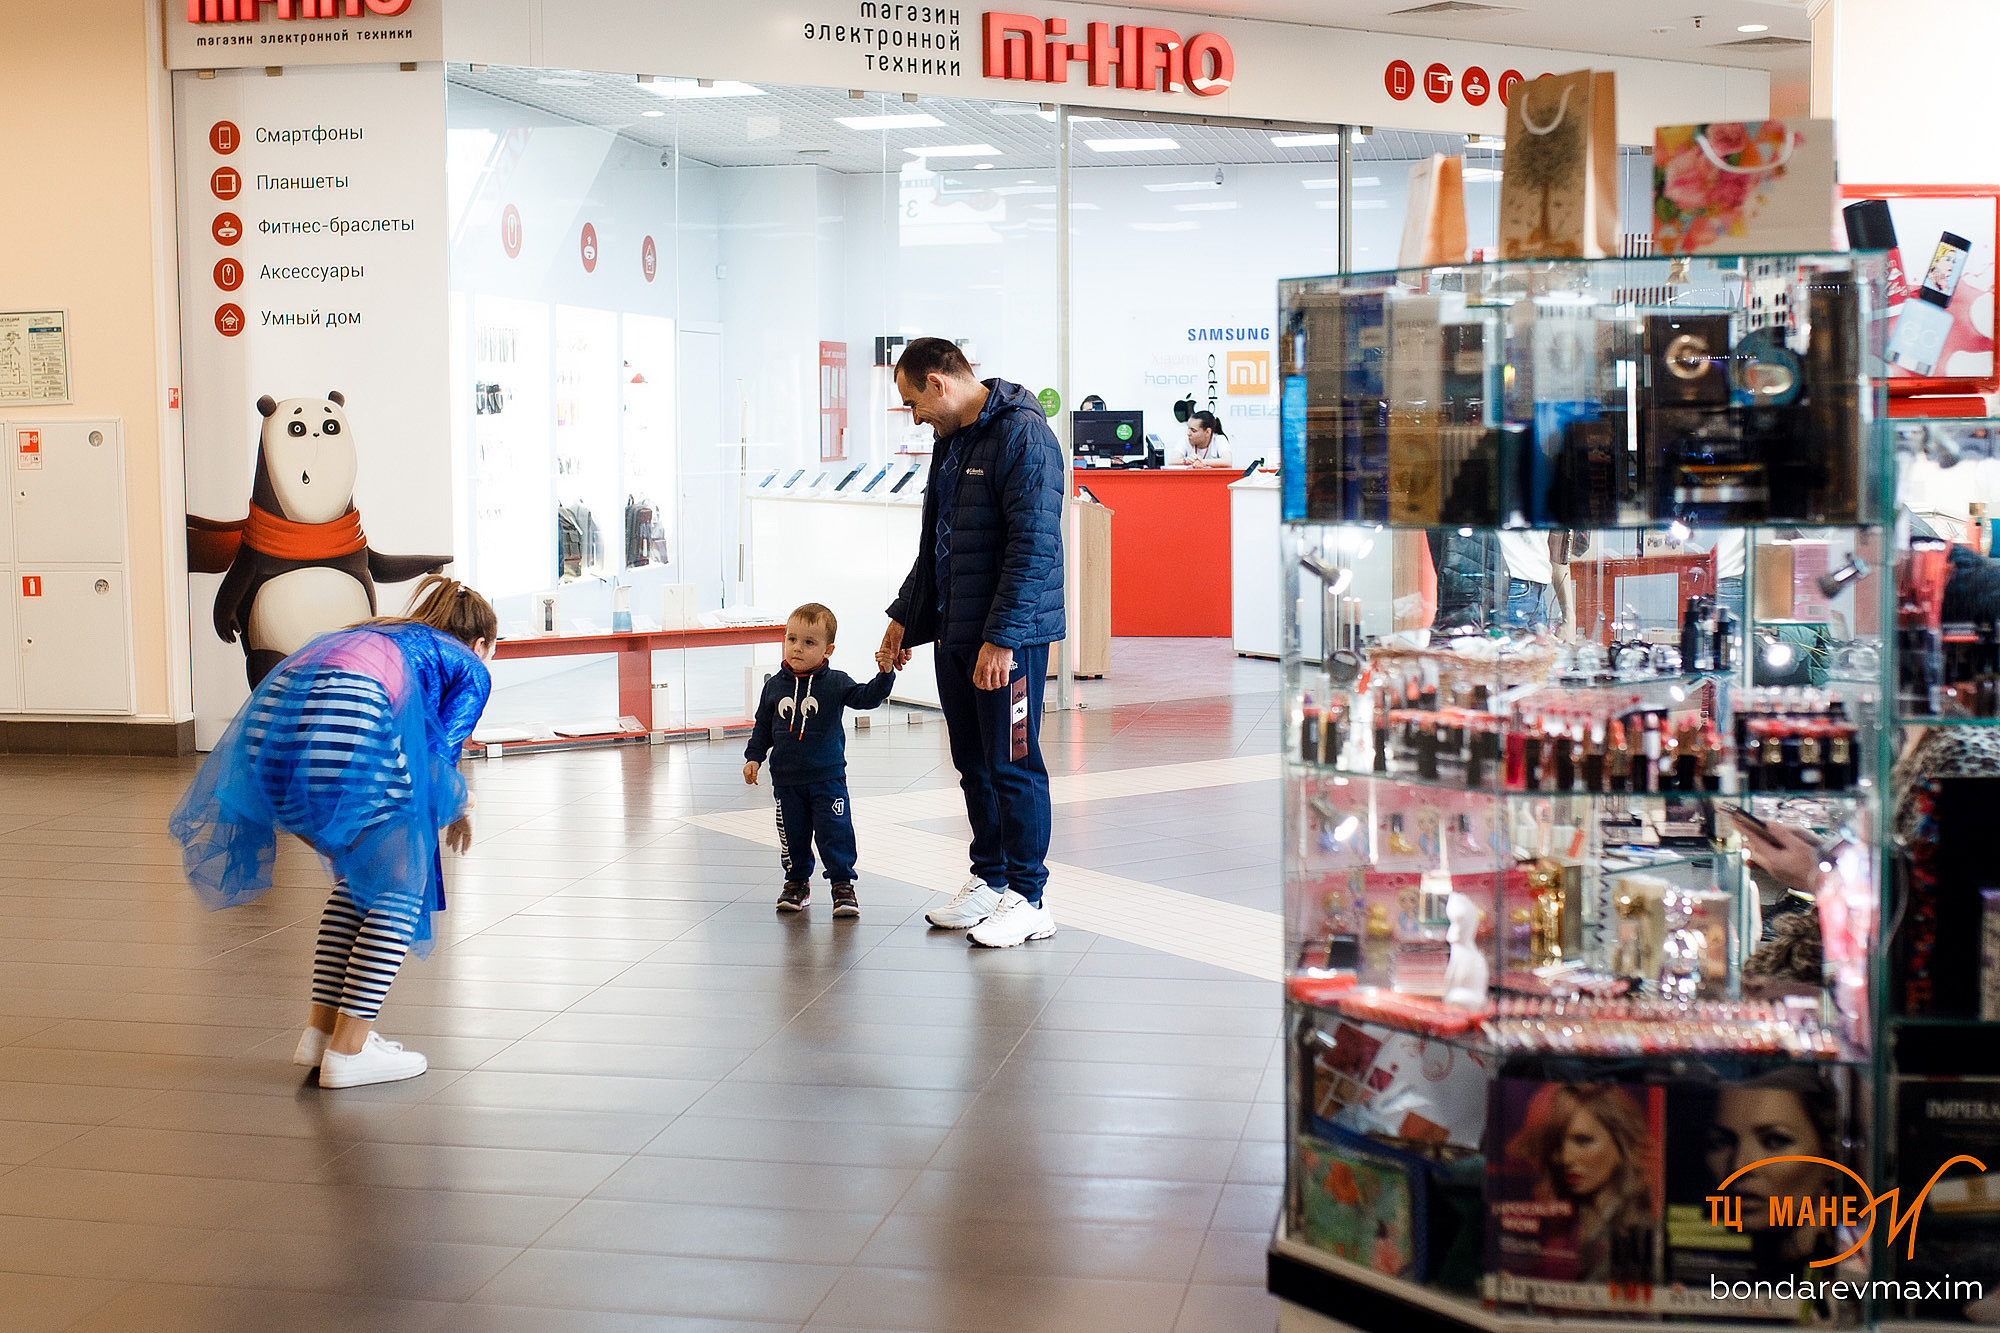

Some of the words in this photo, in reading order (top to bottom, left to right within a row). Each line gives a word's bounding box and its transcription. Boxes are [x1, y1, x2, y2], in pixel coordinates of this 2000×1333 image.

[860, 1, 960, 26] магазин
[196, 35, 254, 47] магазин
[260, 29, 349, 45] электронной
[356, 29, 413, 41] техники
[804, 22, 960, 51] электронной
[864, 54, 960, 77] техники
[255, 124, 364, 145] Смартфоны
[256, 174, 349, 190] Планшеты
[258, 216, 415, 236] Фитнес-браслеты
[259, 264, 365, 282] Аксессуары
[260, 308, 321, 326] Умный
[325, 312, 362, 328] дом
[1187, 327, 1270, 342] SAMSUNG
[1144, 371, 1199, 385] honor
